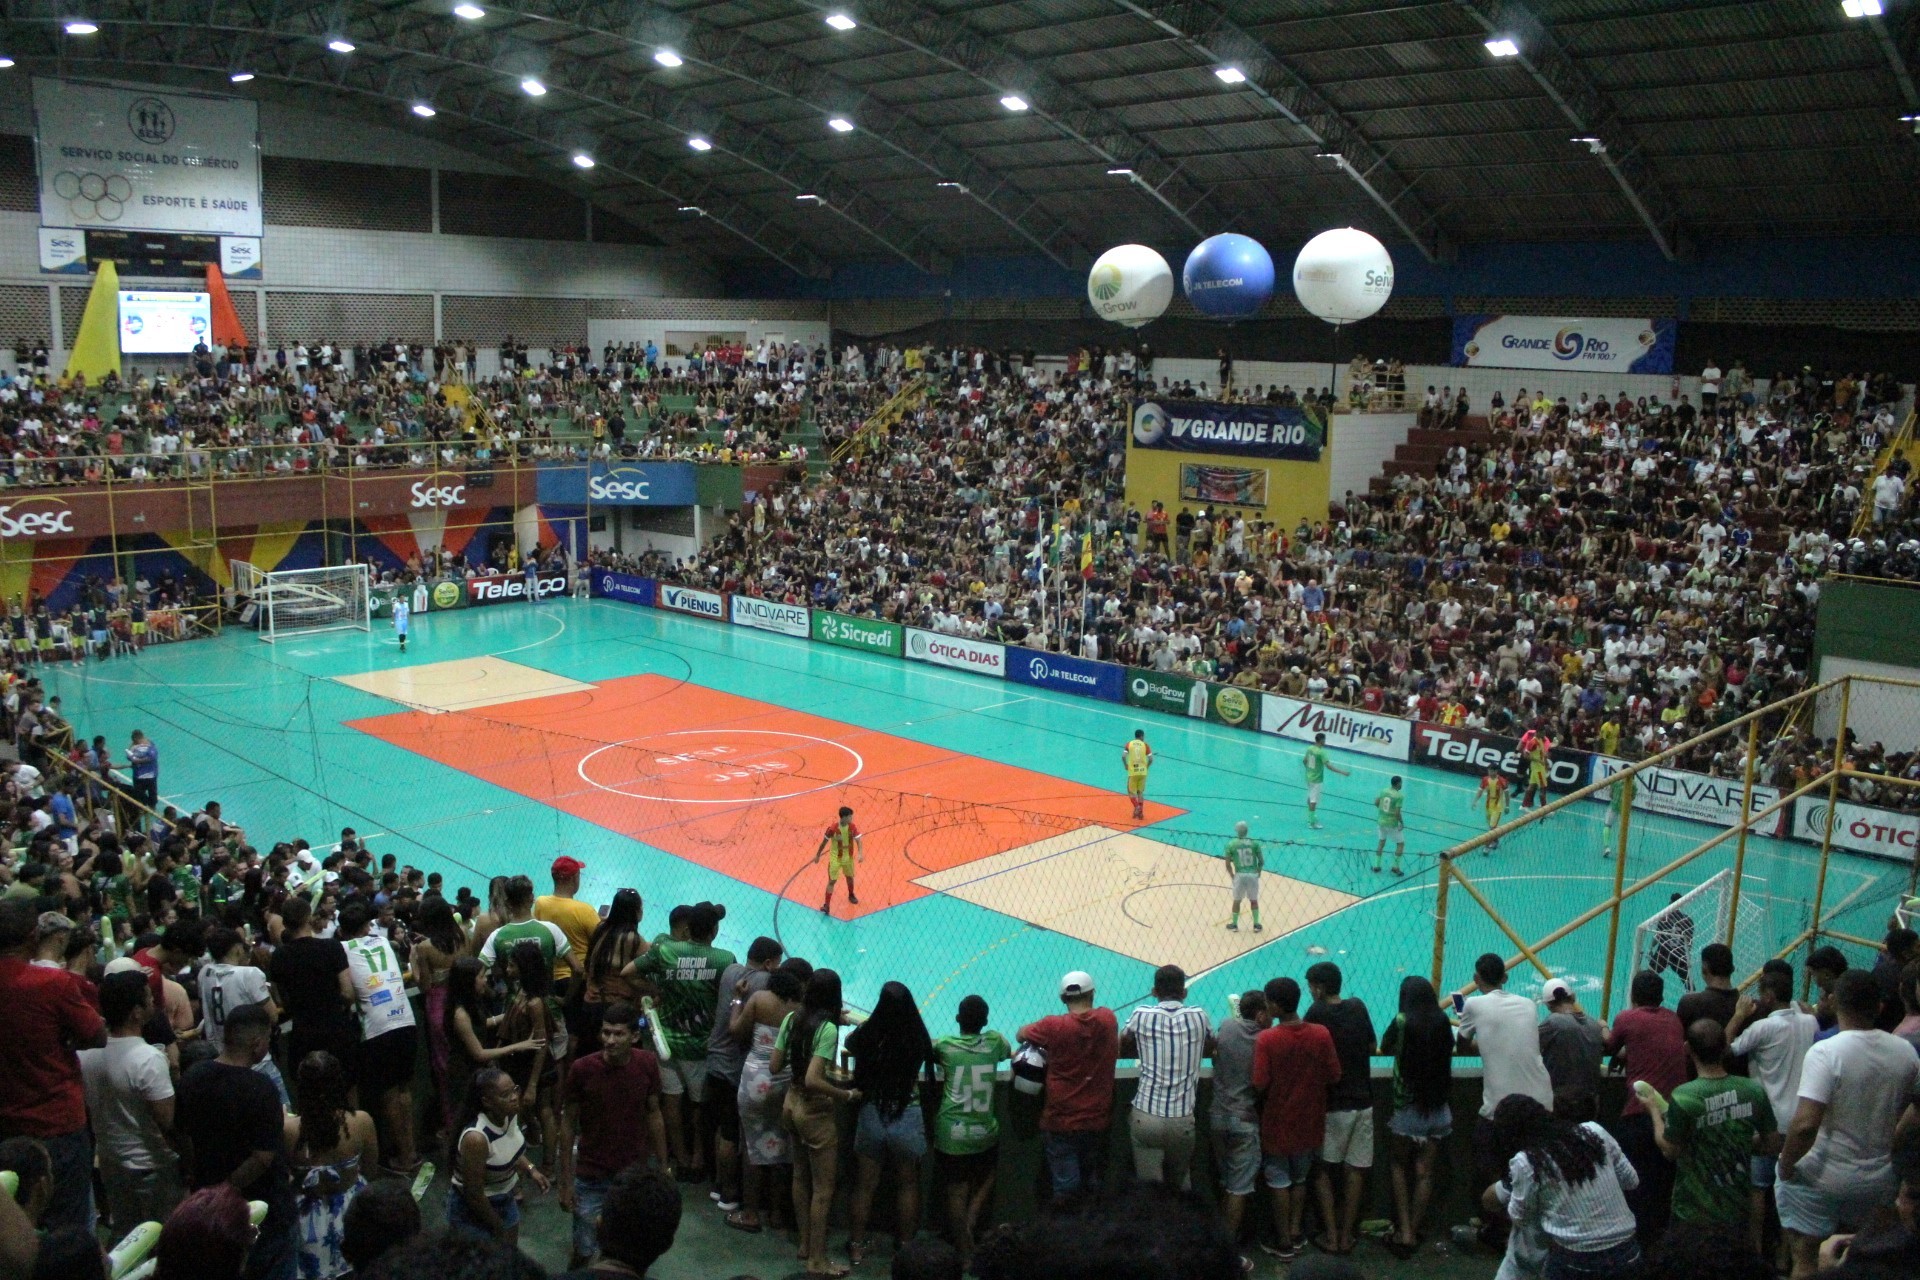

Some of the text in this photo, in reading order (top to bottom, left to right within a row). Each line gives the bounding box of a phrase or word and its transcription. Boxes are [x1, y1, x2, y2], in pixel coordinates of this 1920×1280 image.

[61, 146, 113, 161] SERVIÇO
[118, 150, 159, 165] SOCIAL
[163, 154, 179, 167] DO
[143, 195, 195, 208] ESPORTE
[212, 197, 248, 212] SAÚDE
[1203, 277, 1244, 290] TELECOM
[1502, 334, 1551, 350] GRANDE
[1582, 352, 1617, 361] FM 100.7
[1271, 423, 1306, 445] RIO
[411, 481, 466, 508] Sesc
[590, 475, 650, 500] Sesc
[840, 621, 892, 648] Sicredi
[929, 639, 999, 667] ÓTICA DIAS
[1050, 668, 1096, 685] JR TELECOM
[1277, 703, 1394, 746] Multifrios
[360, 945, 388, 973] 17
[677, 956, 707, 969] TORCIDA
[676, 969, 695, 981] CASA
[697, 969, 717, 980] NOVA
[951, 1064, 994, 1113] 45
